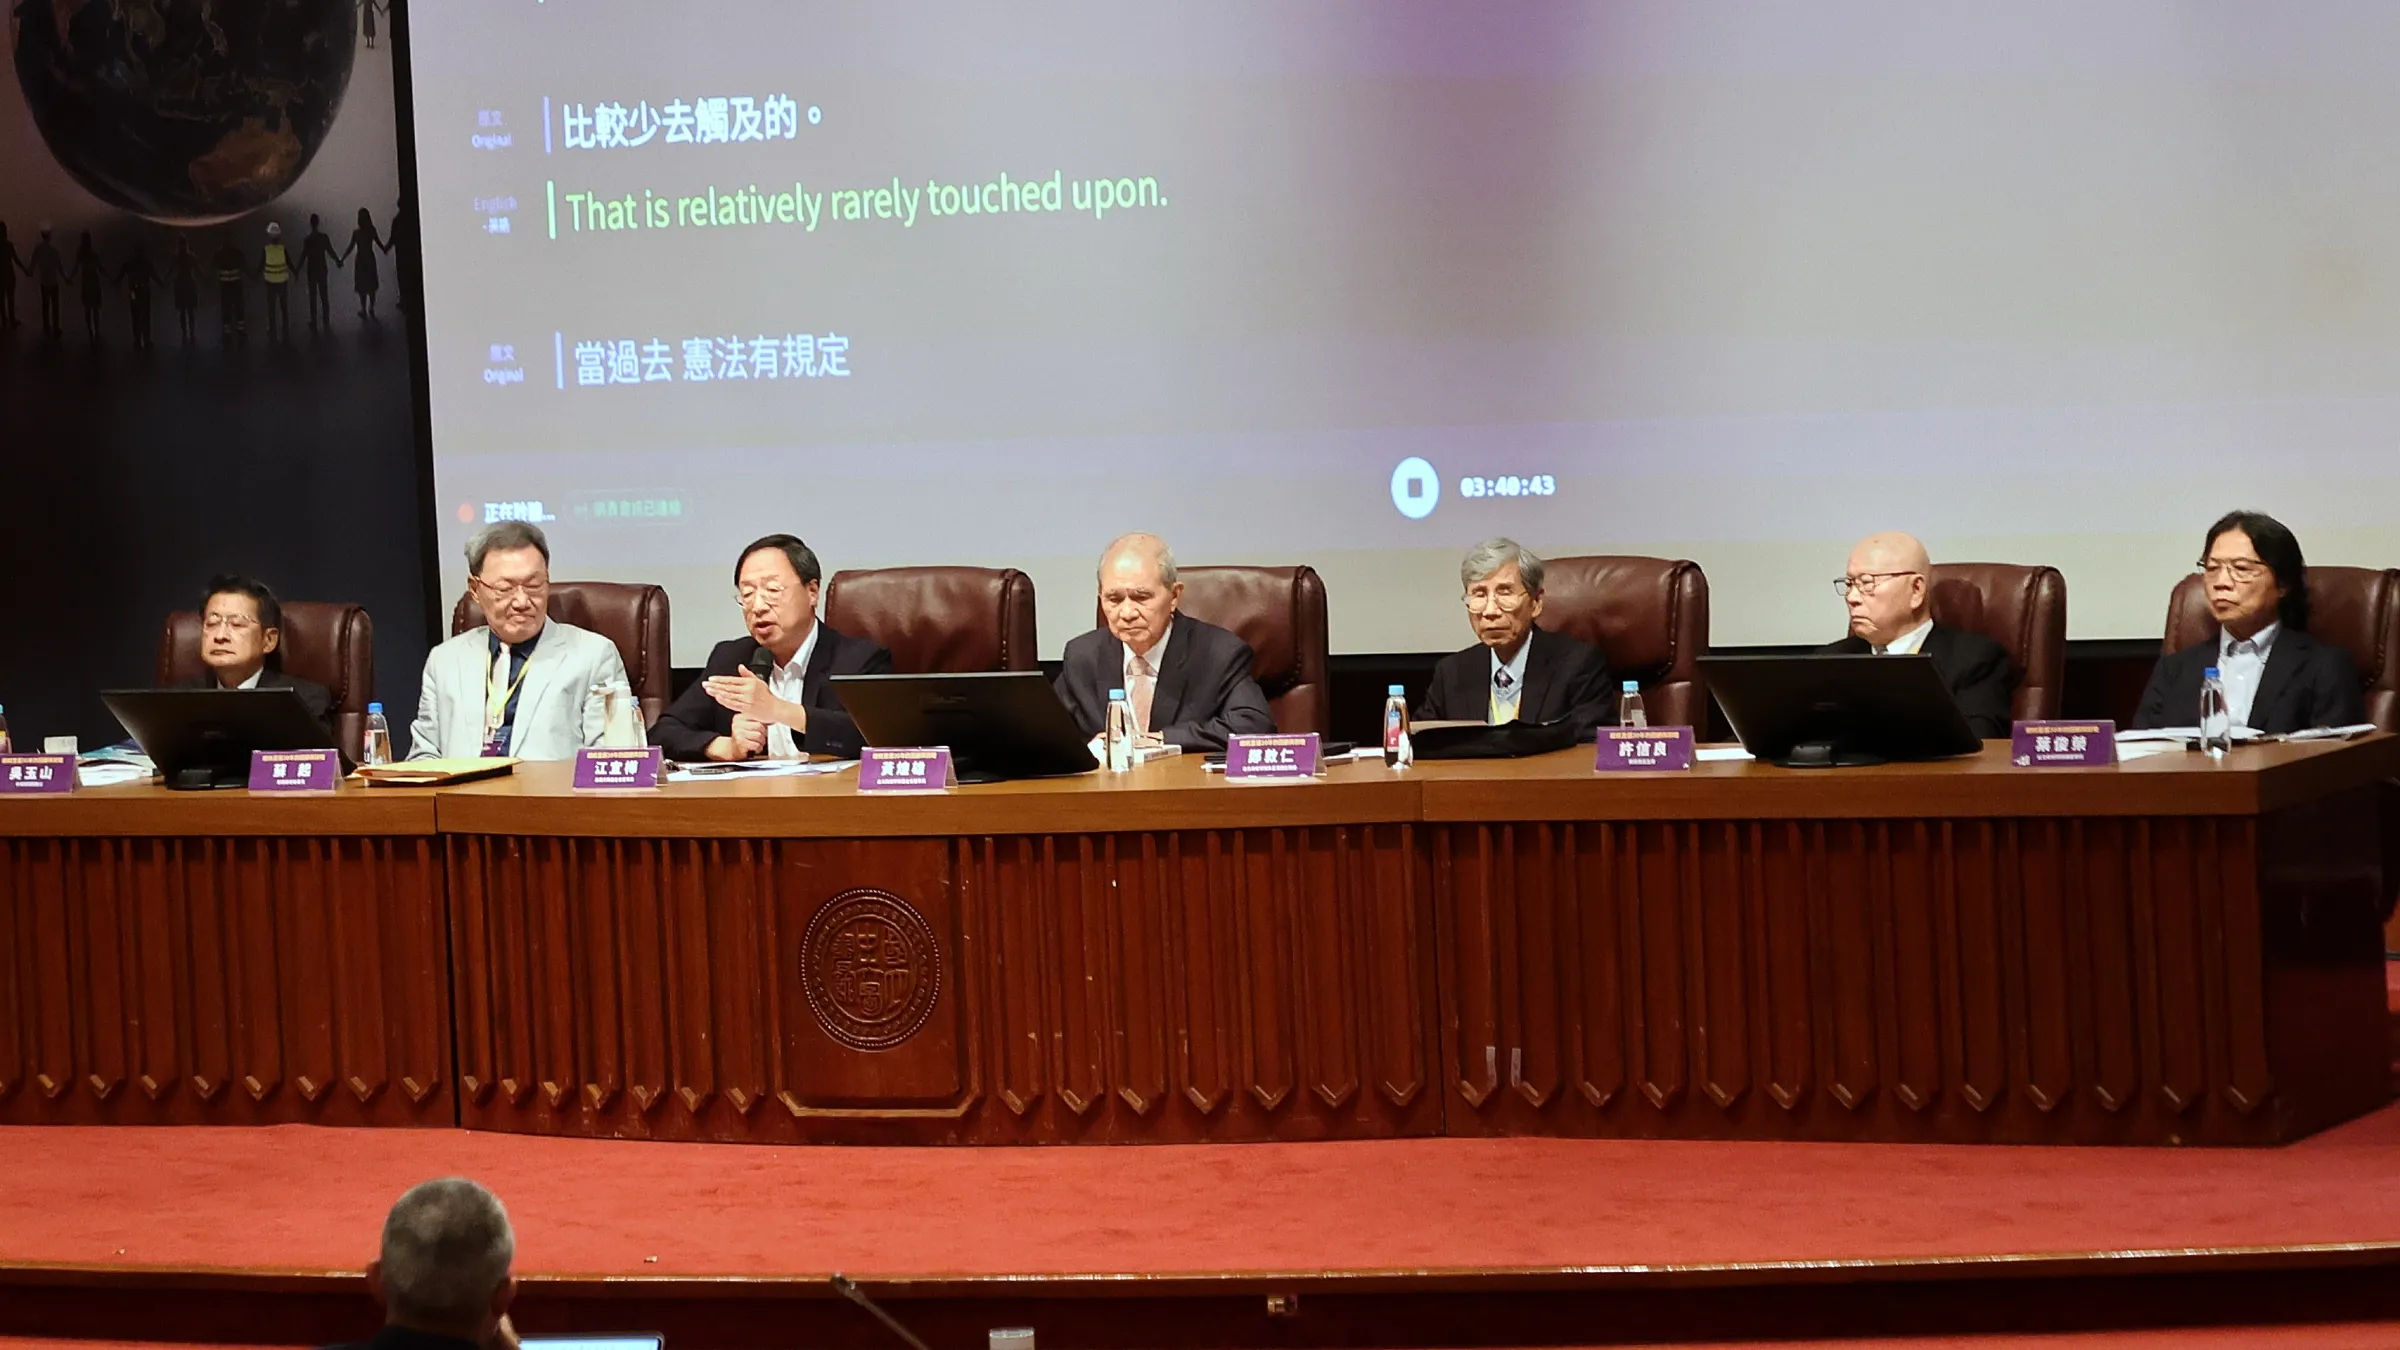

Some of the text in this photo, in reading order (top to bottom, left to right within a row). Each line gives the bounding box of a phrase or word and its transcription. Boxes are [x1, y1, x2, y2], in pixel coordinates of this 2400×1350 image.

[562, 93, 822, 149] 比較少去觸及的。
[566, 170, 1169, 232] That is relatively rarely touched upon.
[575, 333, 851, 386] 當過去 憲法有規定
[1460, 475, 1556, 498] 03:40:43
